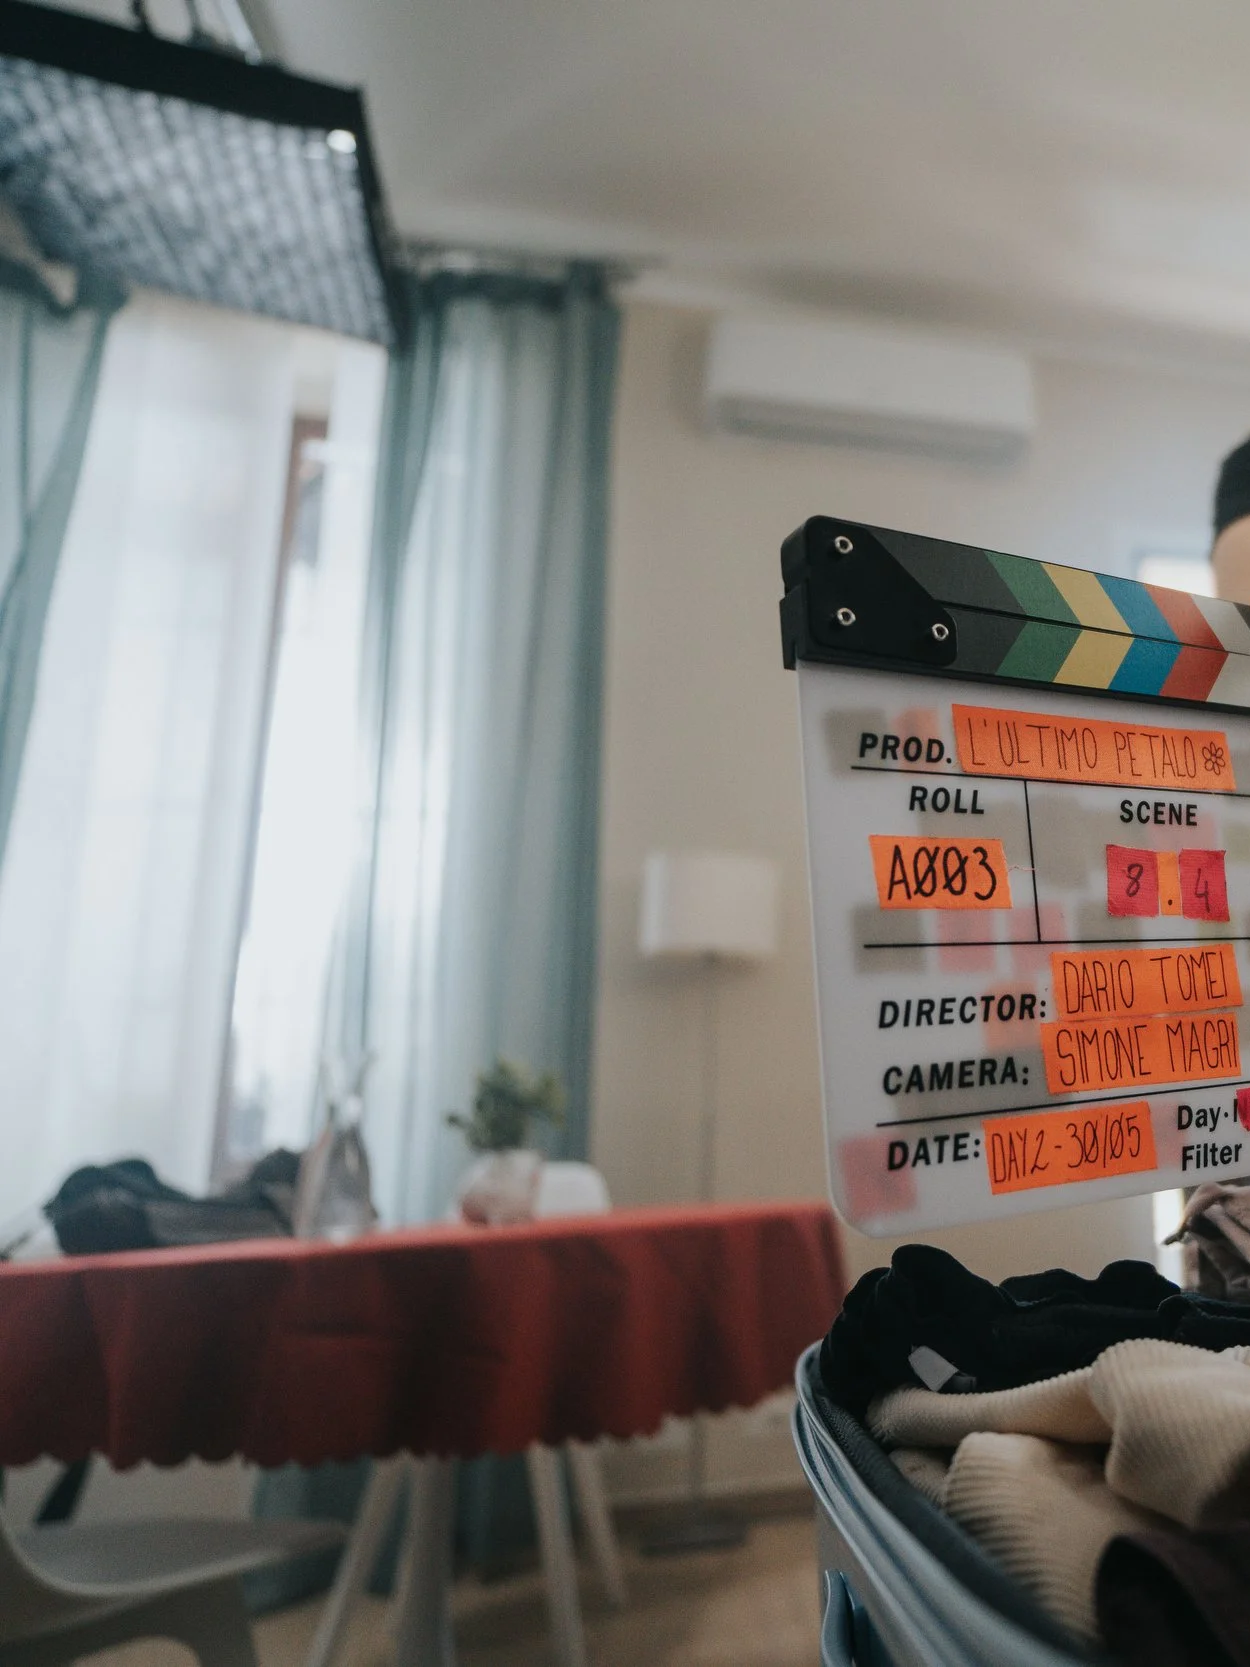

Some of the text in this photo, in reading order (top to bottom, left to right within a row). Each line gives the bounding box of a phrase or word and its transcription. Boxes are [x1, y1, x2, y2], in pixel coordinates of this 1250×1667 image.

[858, 732, 953, 764] PROD.
[967, 717, 1197, 779] L'ULTIMO PETALO
[908, 785, 985, 815] ROLL
[1119, 799, 1198, 827] SCENE
[1063, 950, 1228, 1015] DARIO TOMEI
[877, 993, 1047, 1029] DIRECTOR:
[1055, 1019, 1238, 1087] SIMONE MAGRI
[882, 1056, 1029, 1096] CAMERA:
[887, 1131, 982, 1171] DATE:
[1181, 1141, 1243, 1172] Filter
